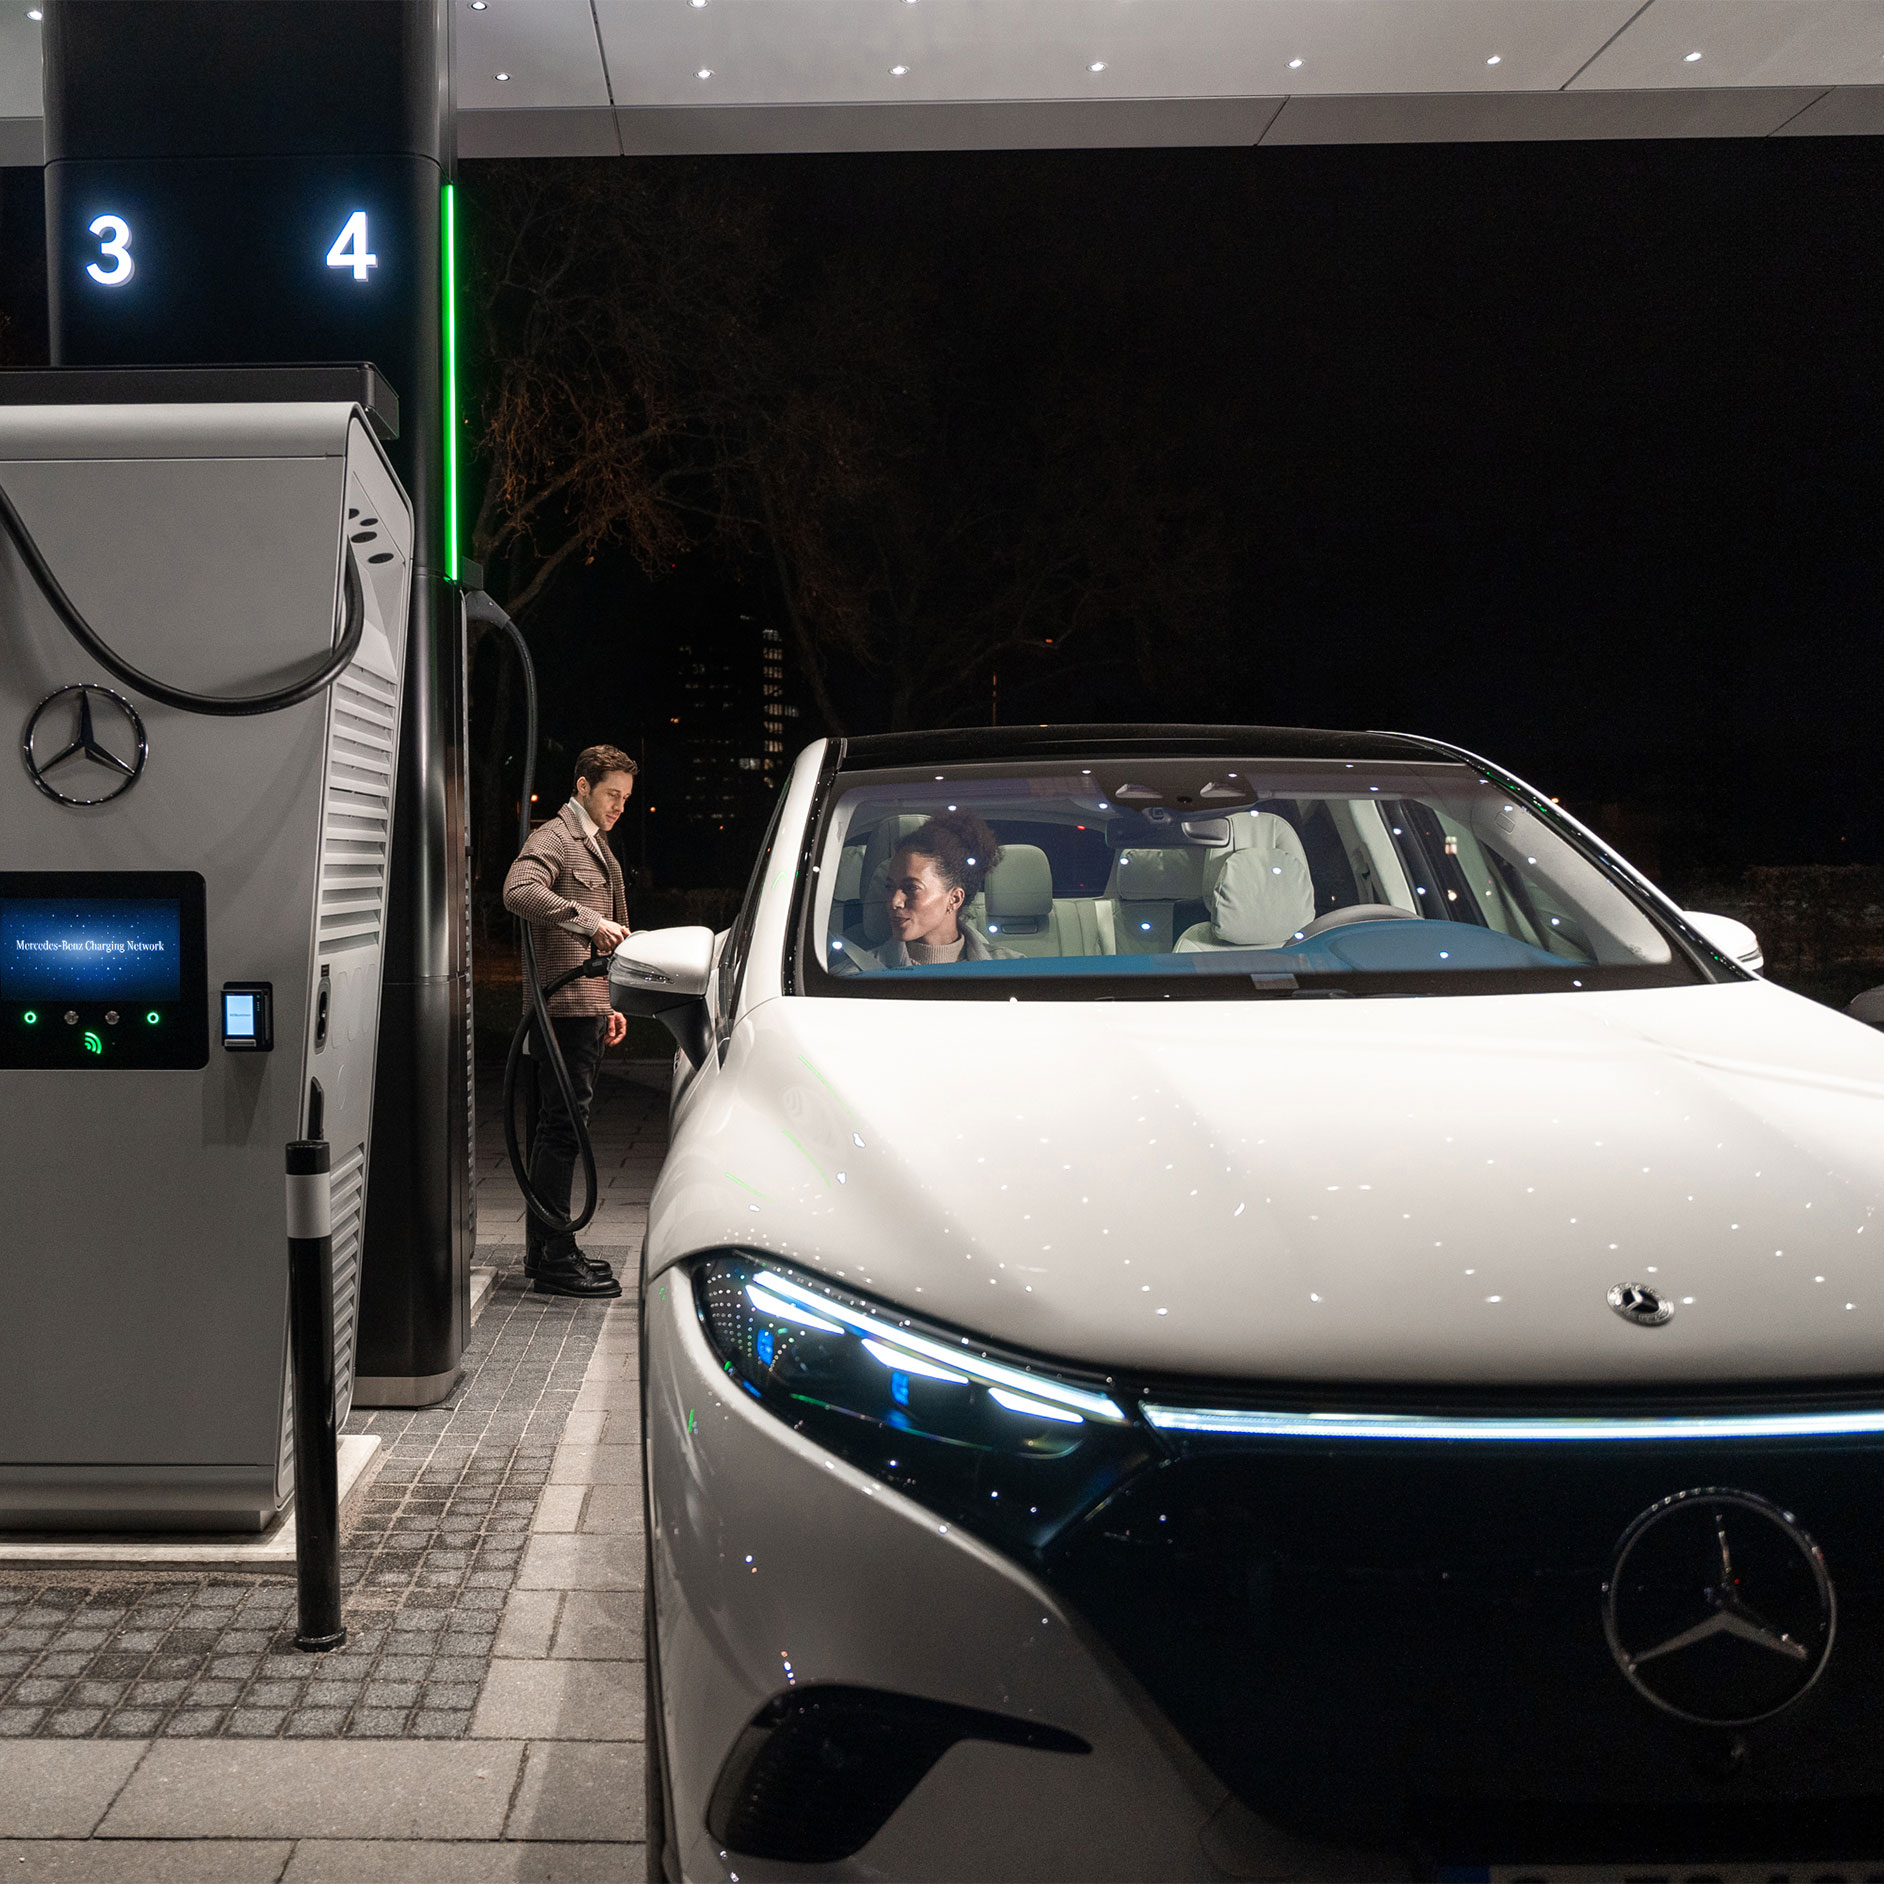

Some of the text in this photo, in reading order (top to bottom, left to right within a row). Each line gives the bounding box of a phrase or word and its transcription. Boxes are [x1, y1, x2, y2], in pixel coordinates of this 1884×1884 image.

[86, 213, 134, 287] 3
[326, 210, 378, 282] 4
[16, 939, 165, 953] Mercedes-Benz Charging Network
